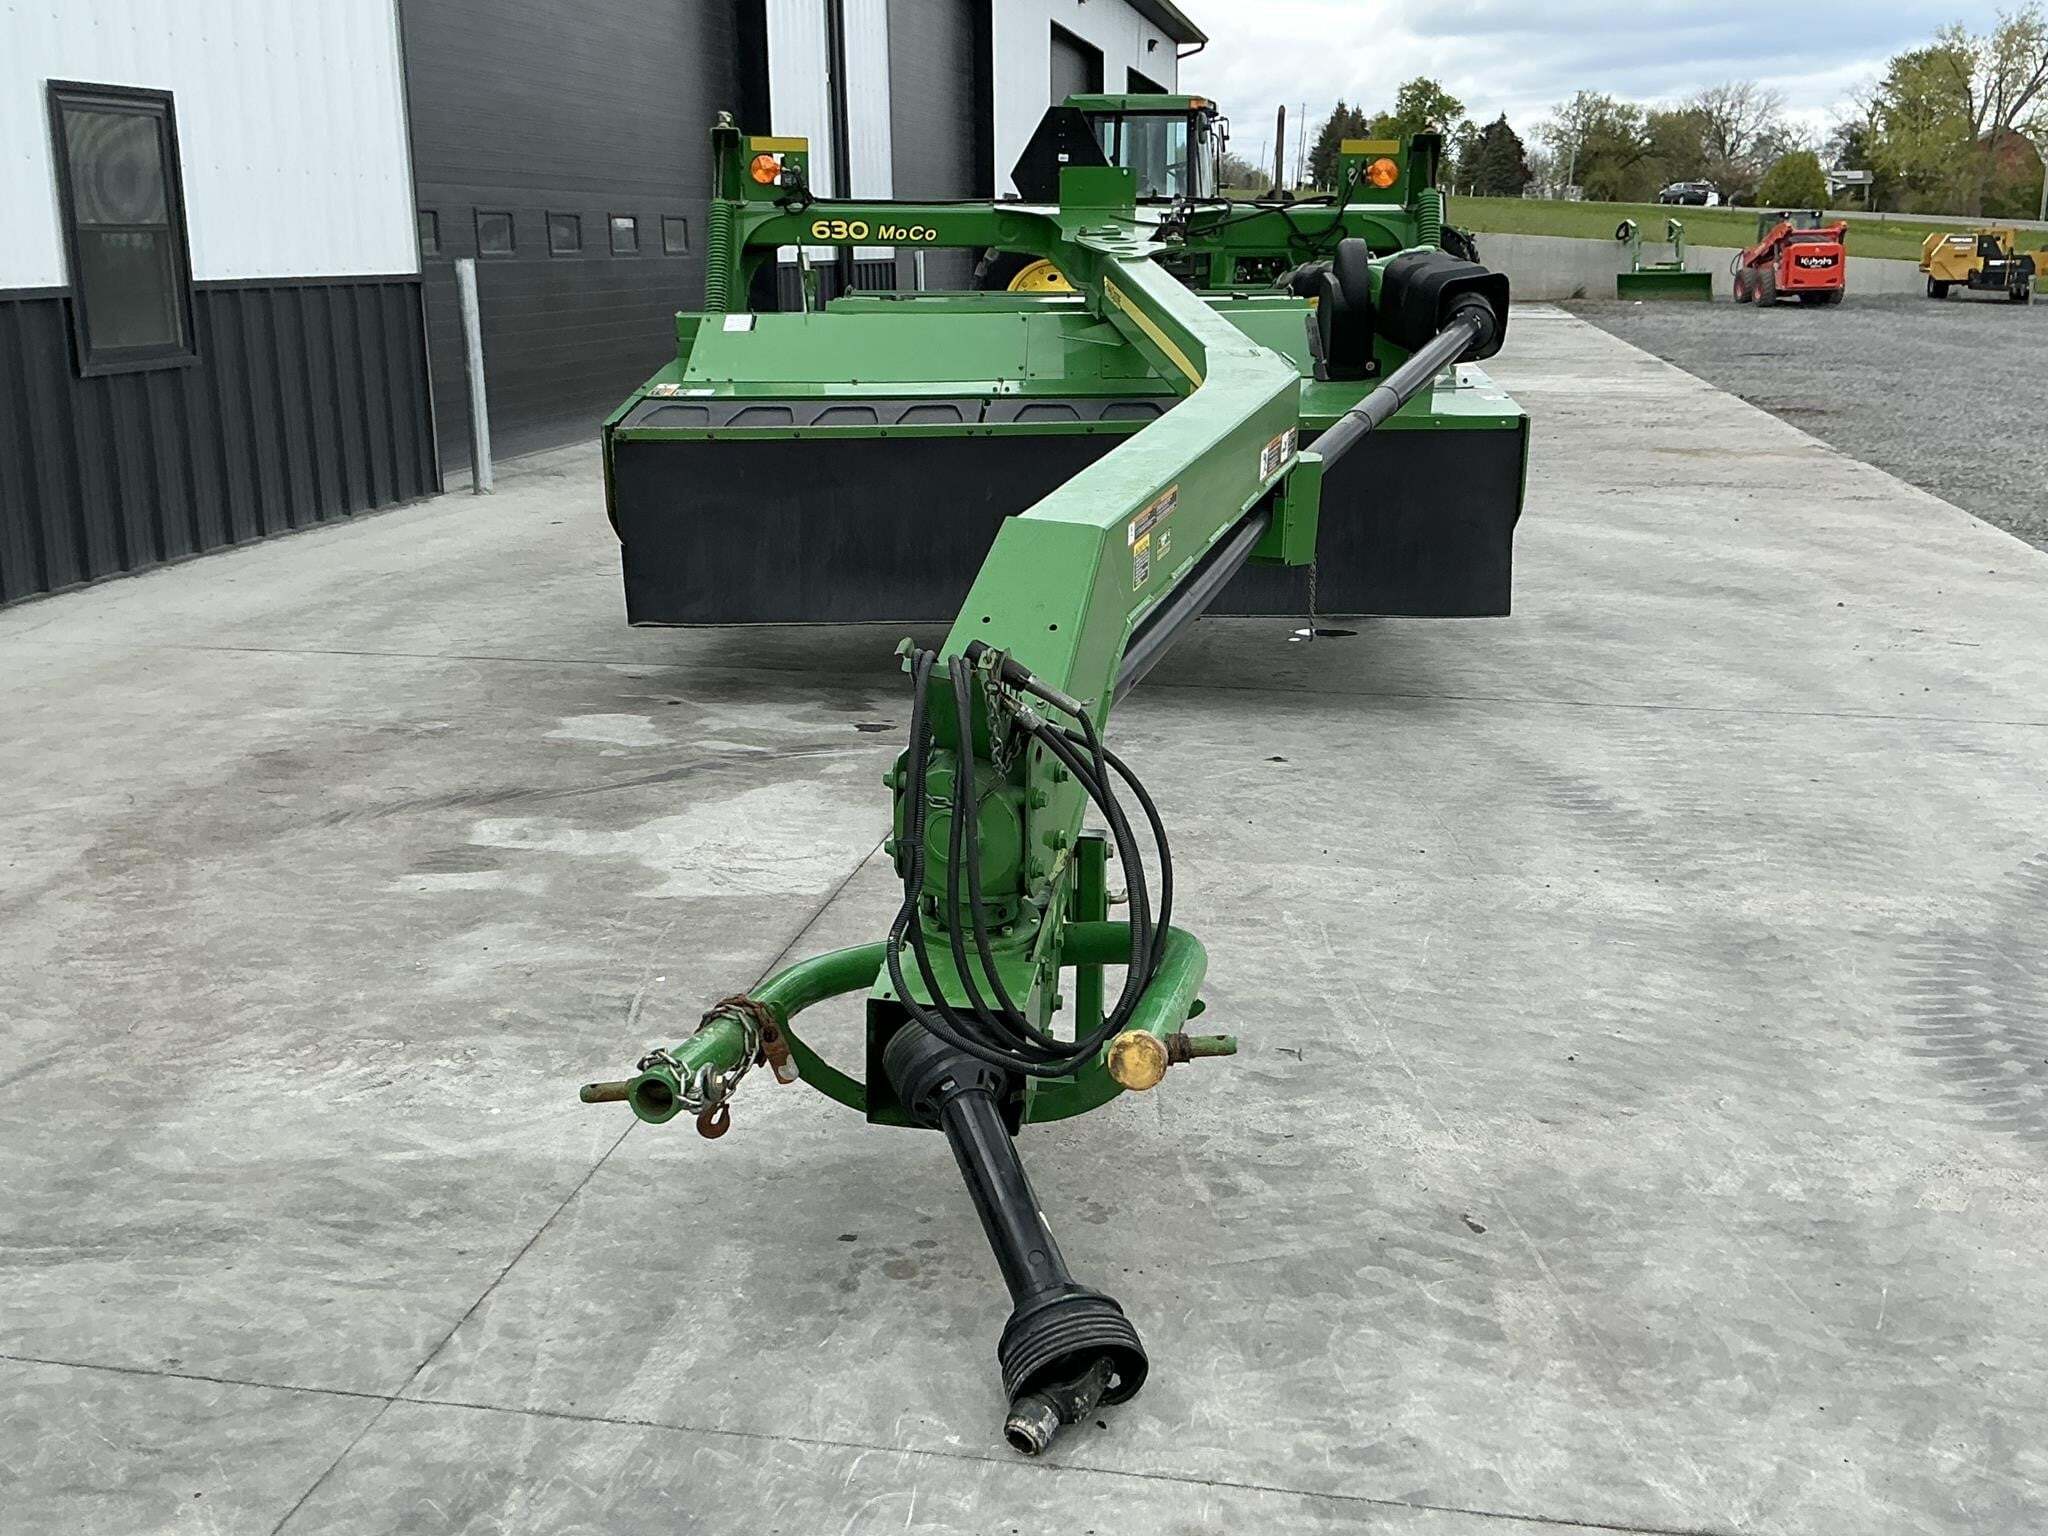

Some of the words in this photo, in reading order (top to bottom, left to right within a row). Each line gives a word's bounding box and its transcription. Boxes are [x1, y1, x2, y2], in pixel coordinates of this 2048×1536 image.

[811, 220, 869, 240] 630
[878, 225, 937, 241] MoCo
[1800, 256, 1833, 266] Kubota
